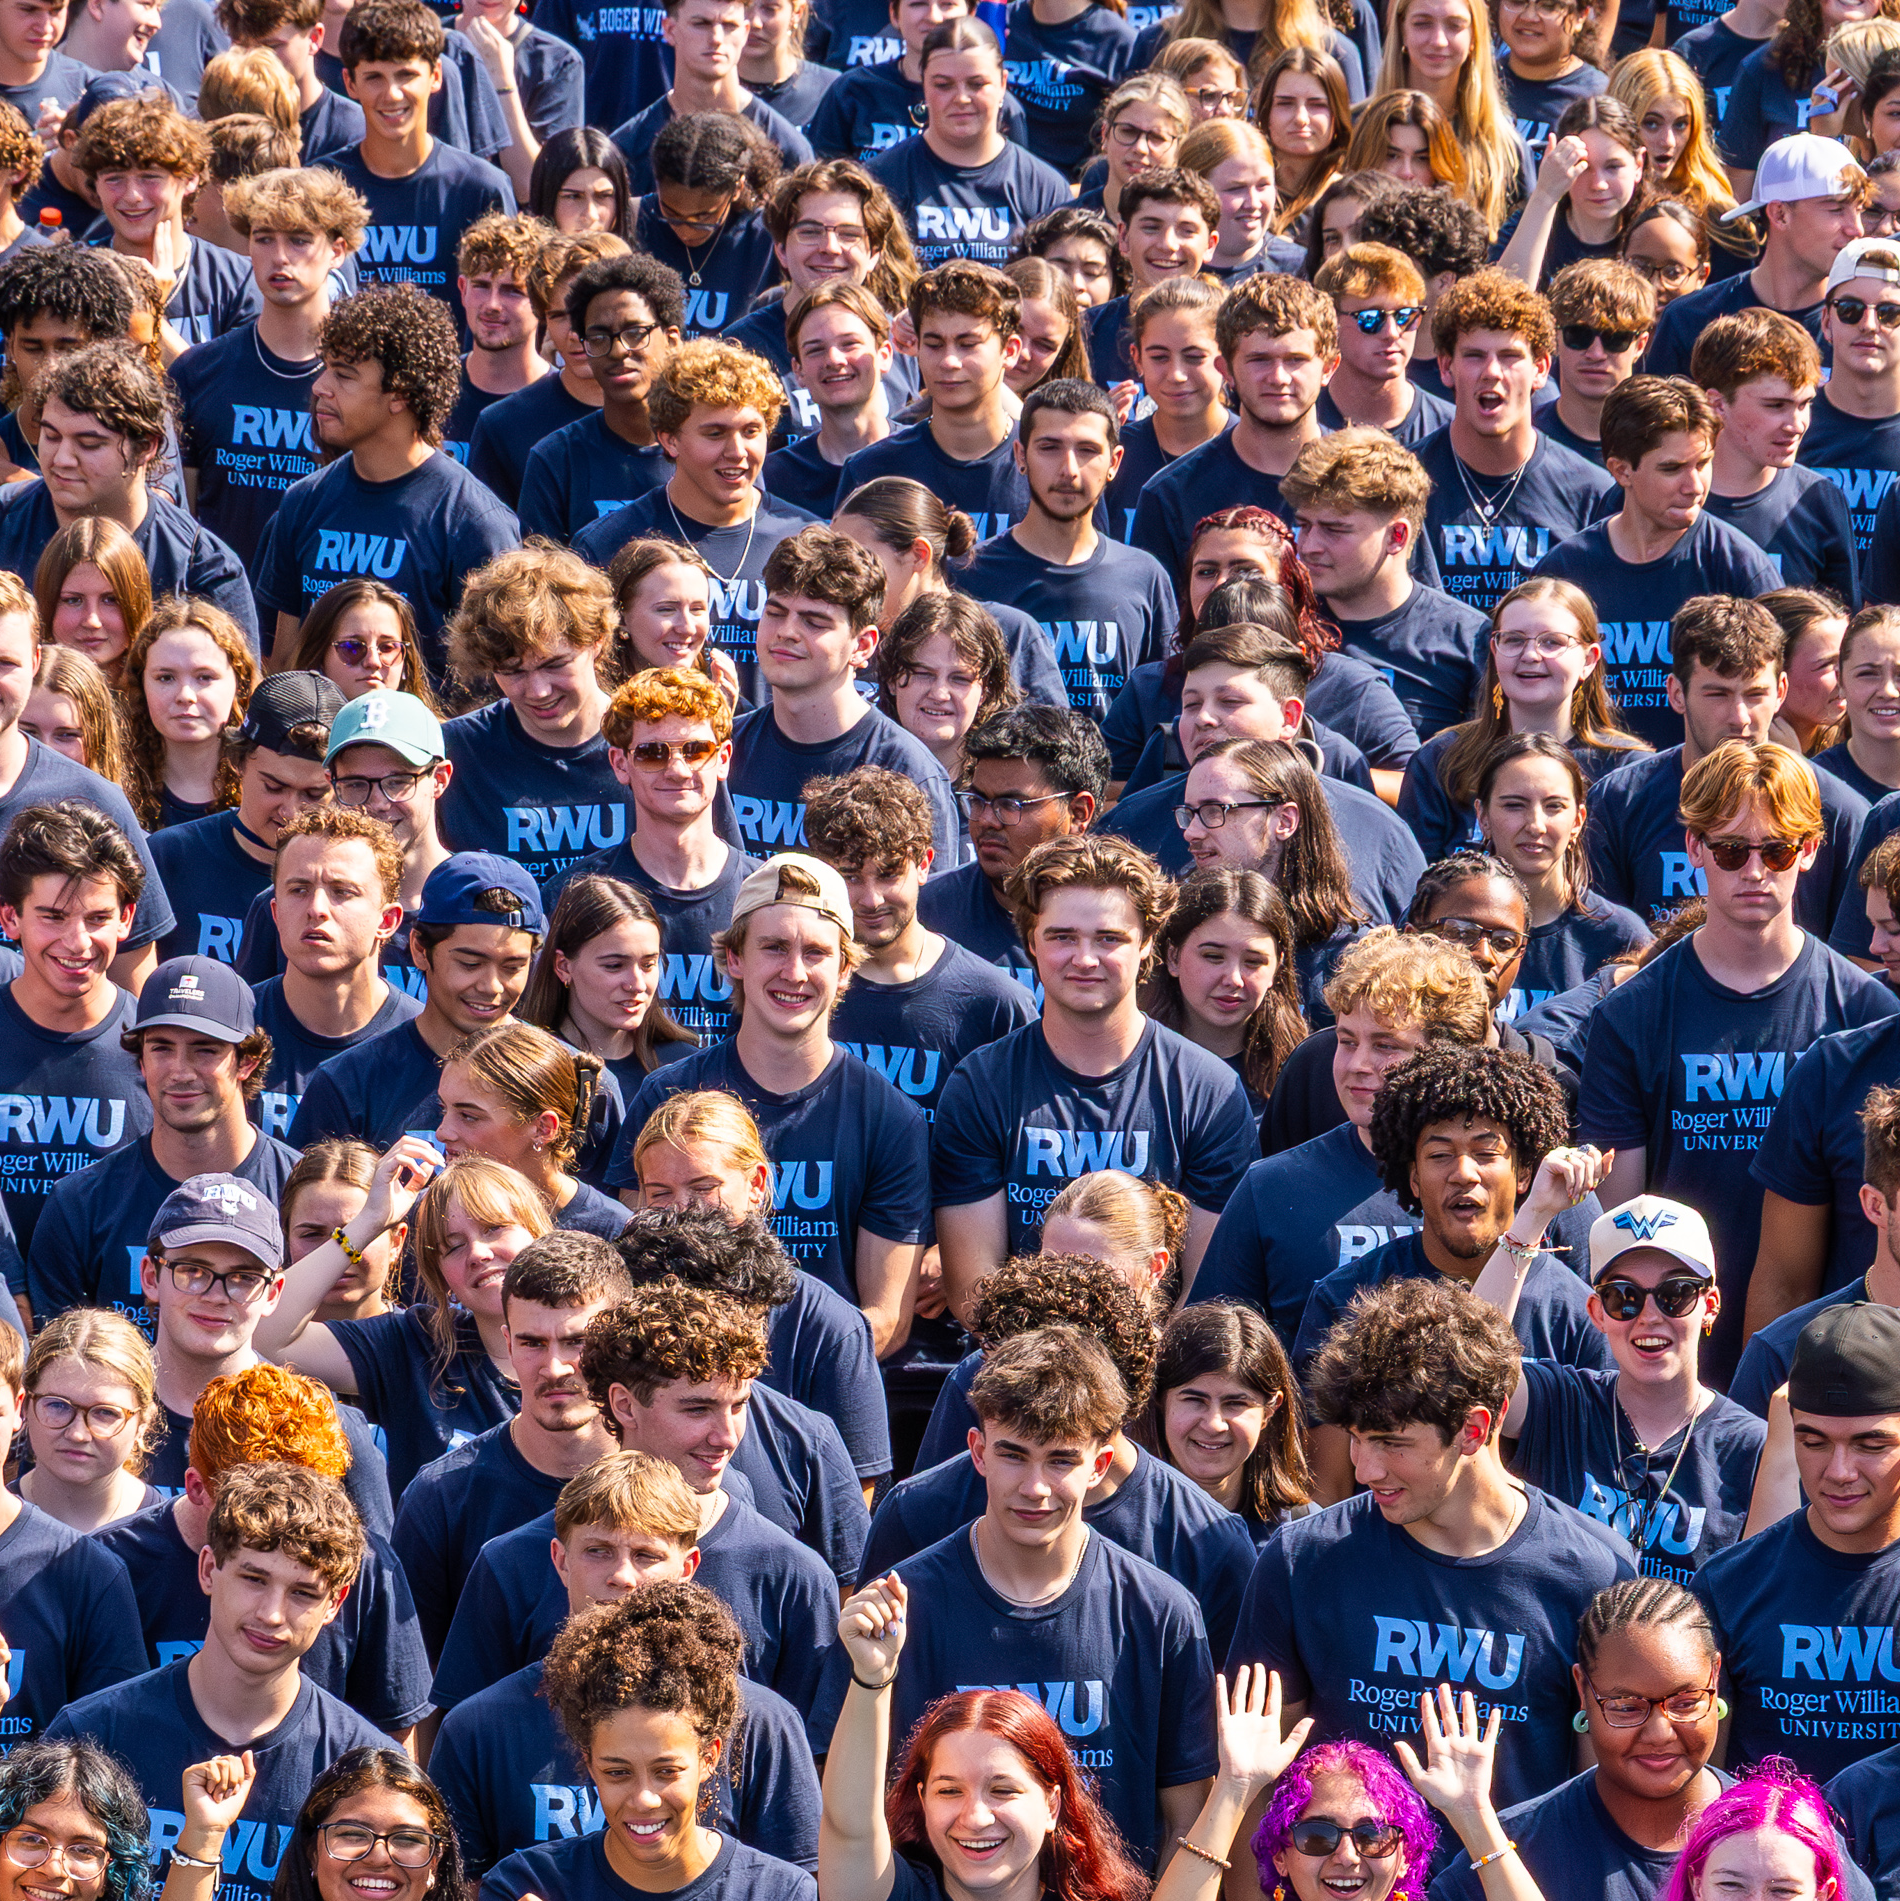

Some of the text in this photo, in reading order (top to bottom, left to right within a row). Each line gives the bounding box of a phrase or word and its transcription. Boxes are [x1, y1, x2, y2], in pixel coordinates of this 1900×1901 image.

[600, 11, 639, 33] ROGER
[847, 37, 906, 65] RW
[916, 206, 1009, 239] RWU
[380, 266, 445, 284] Williams
[216, 448, 321, 472] Roger Willia
[315, 530, 405, 577] RWU
[1442, 525, 1549, 567] RWU
[707, 577, 768, 620] WU
[1441, 574, 1477, 591] oger
[1049, 621, 1116, 663] WU
[1624, 669, 1672, 688] Willia
[359, 697, 391, 729] B
[503, 803, 625, 851] RWU
[659, 954, 732, 1001] WU
[1671, 1108, 1727, 1131] Roger
[1025, 1127, 1149, 1176] RWU
[773, 1161, 833, 1210] WU
[1373, 1616, 1526, 1691] RWU
[1349, 1679, 1421, 1714] Roger
[1762, 1686, 1830, 1717] Roger
[530, 1784, 604, 1841] RW
